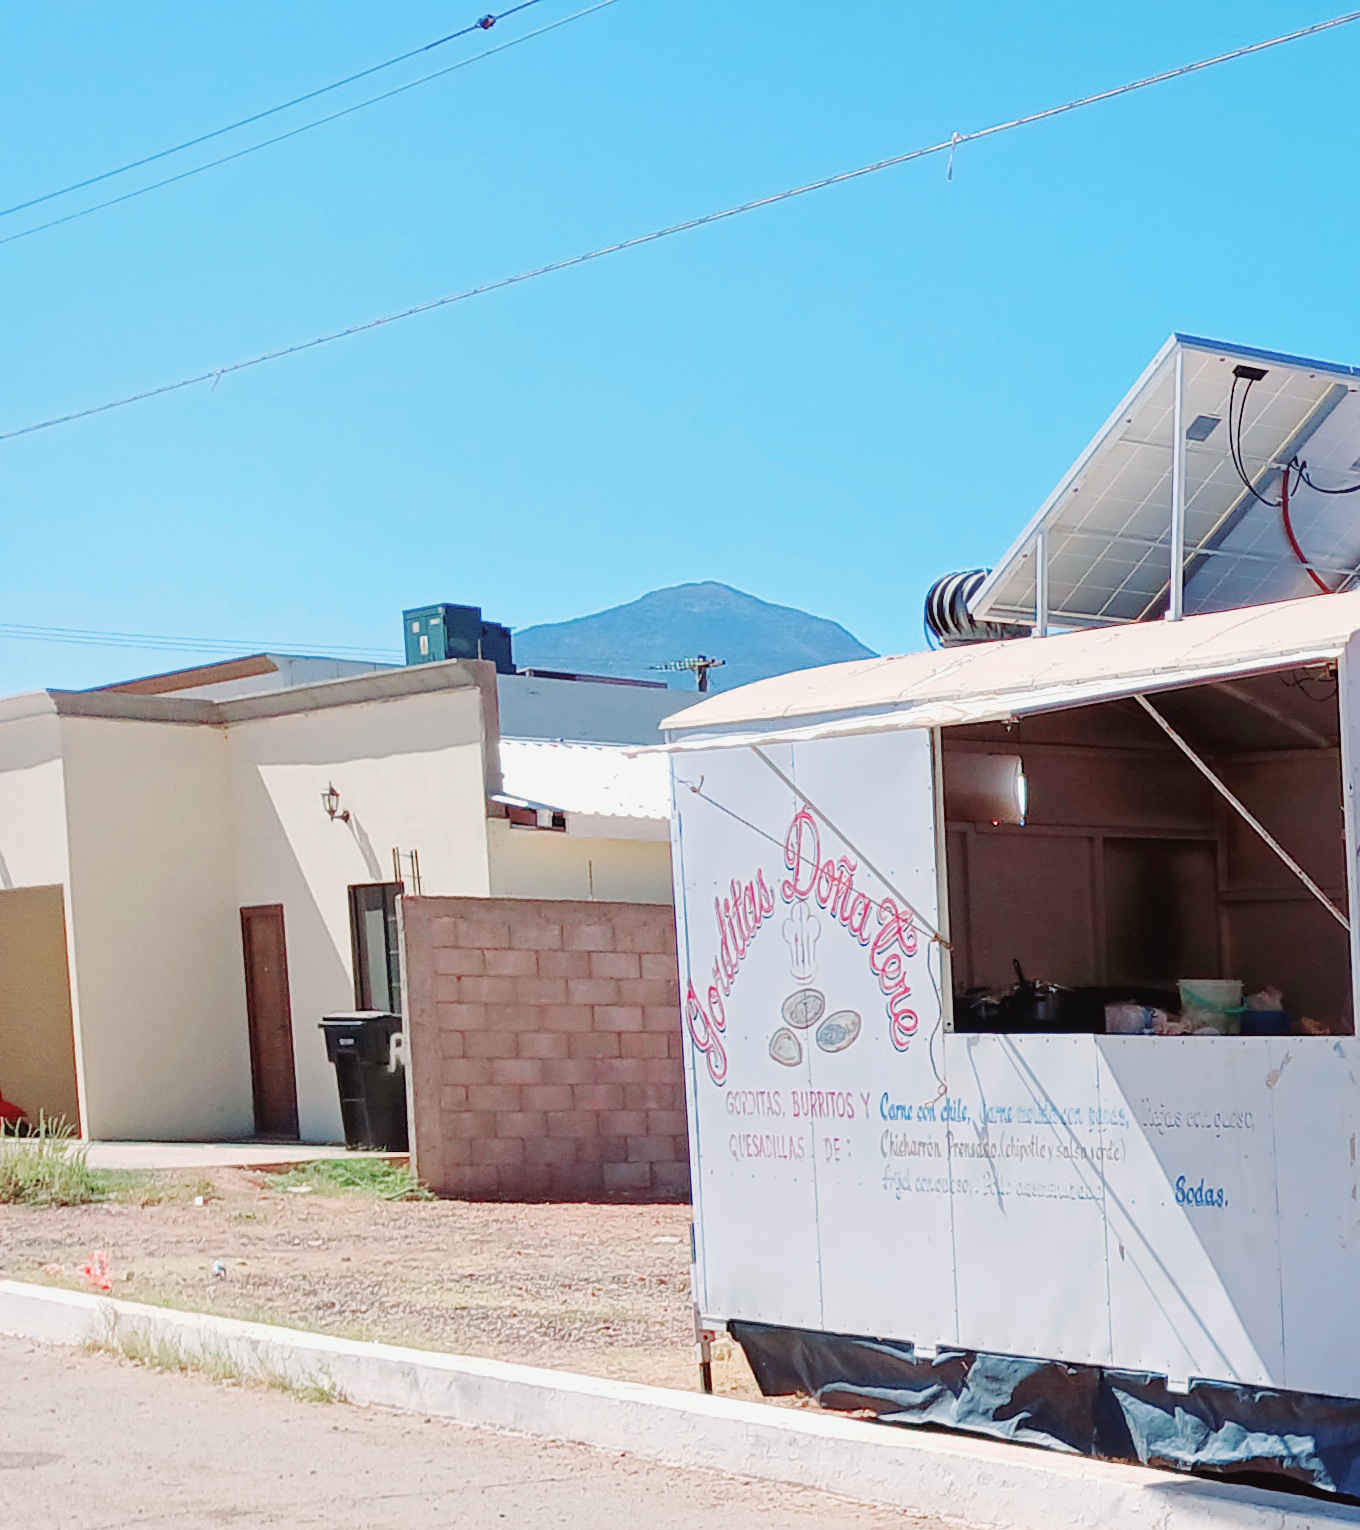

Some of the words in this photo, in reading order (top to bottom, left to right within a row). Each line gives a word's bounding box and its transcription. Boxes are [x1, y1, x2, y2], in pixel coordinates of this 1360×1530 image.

[685, 868, 775, 1086] Gorditas
[781, 804, 872, 946] Doña
[870, 896, 920, 1052] Tere
[791, 1090, 855, 1119] BURRITOS
[859, 1091, 871, 1120] Y
[879, 1092, 913, 1121] Carne
[729, 1134, 805, 1161] QUESADILLAS
[1175, 1175, 1229, 1208] Sodas.
